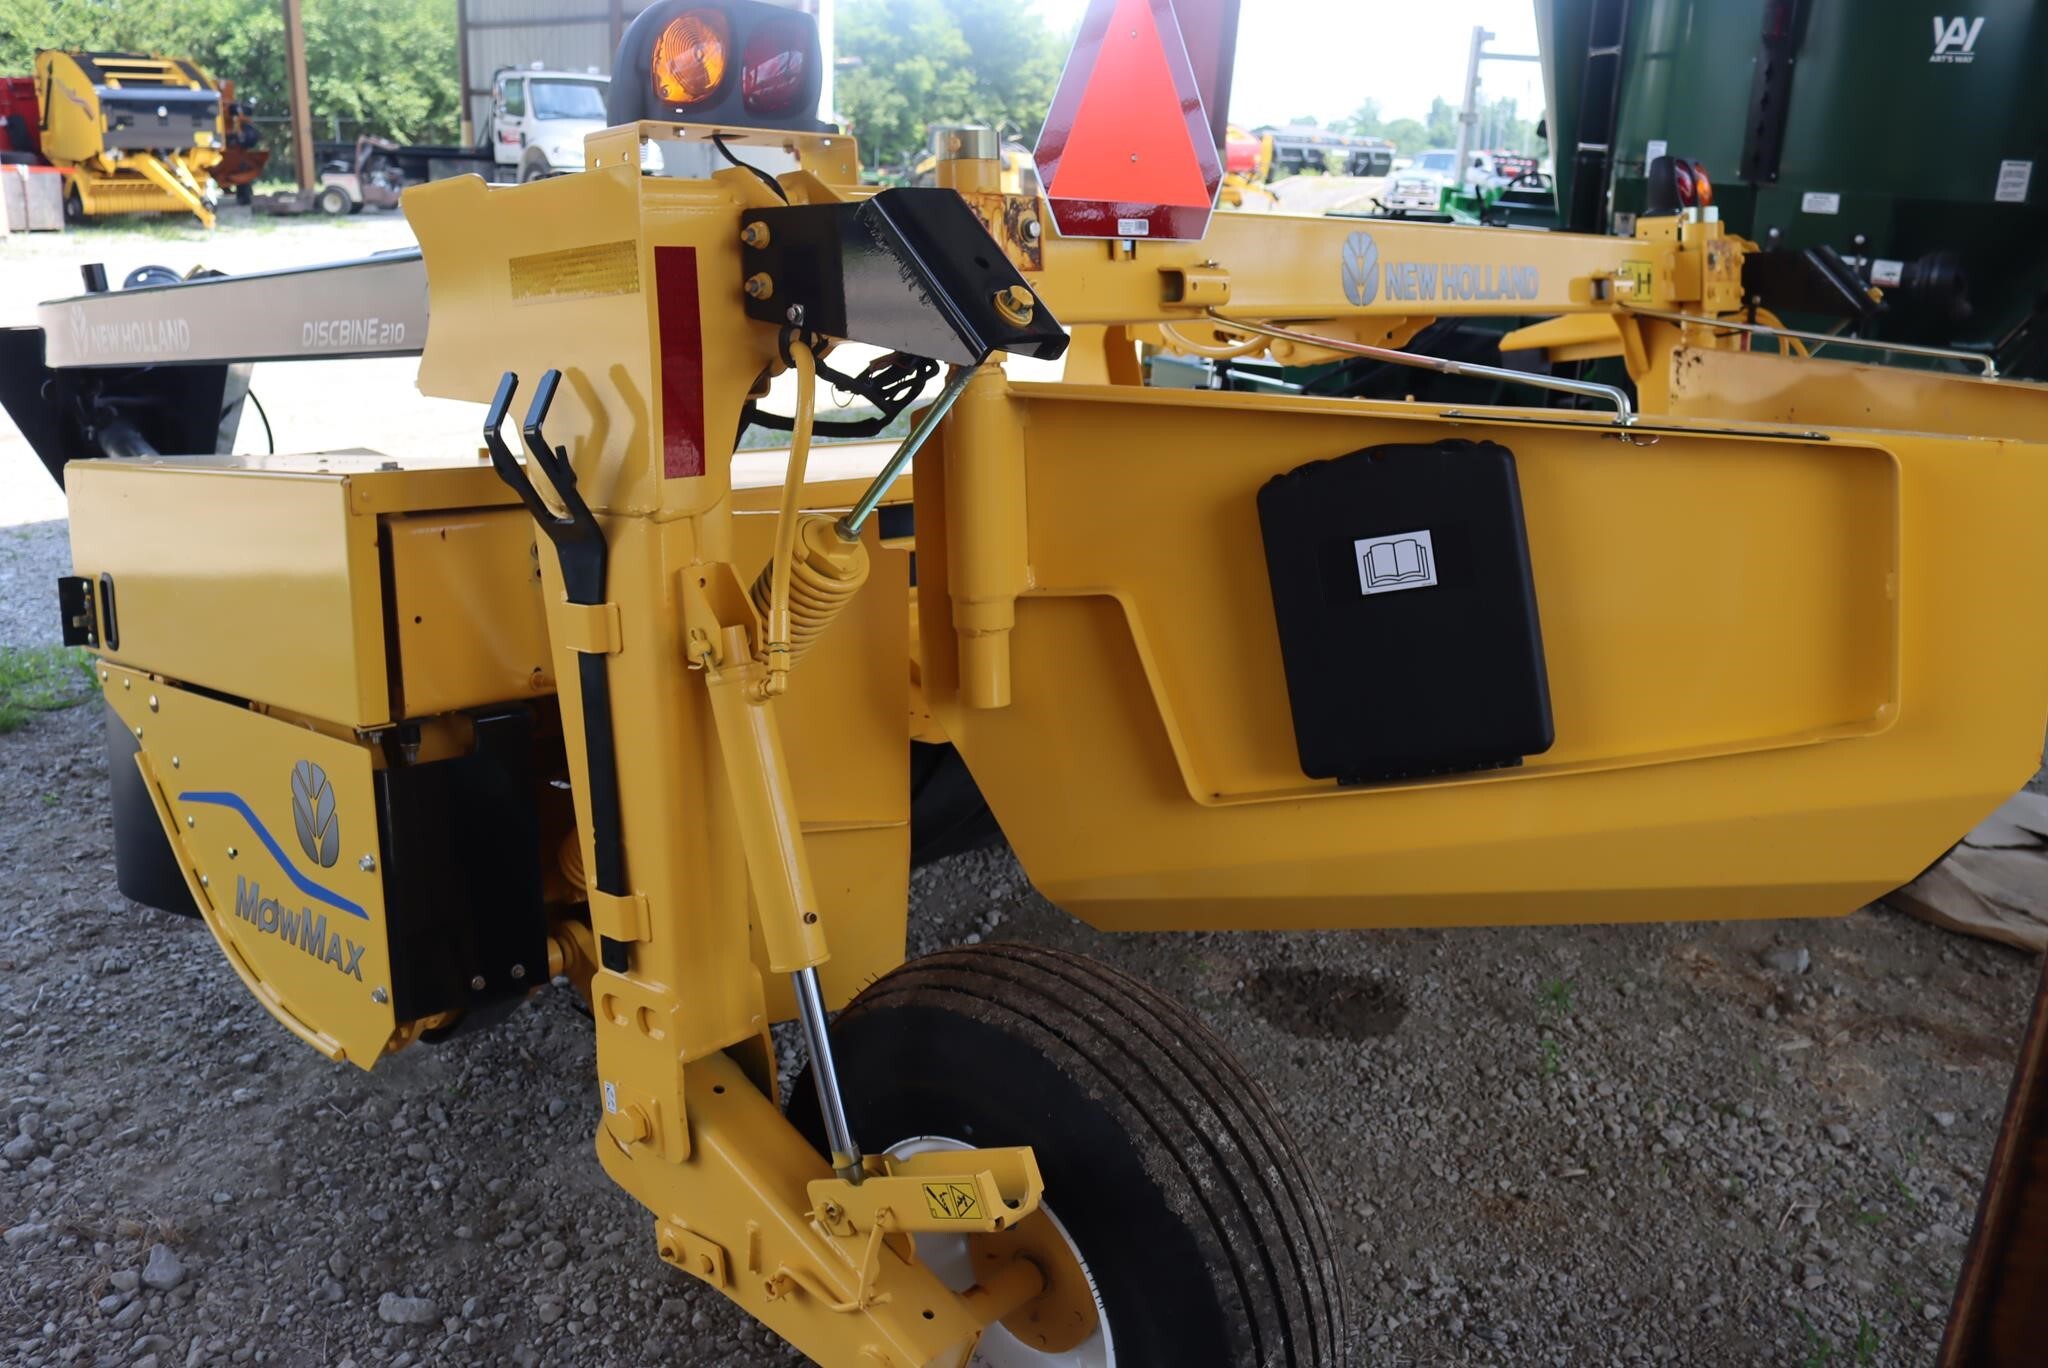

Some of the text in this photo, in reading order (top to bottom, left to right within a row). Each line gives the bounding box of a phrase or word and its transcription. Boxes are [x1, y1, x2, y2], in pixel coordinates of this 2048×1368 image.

[1384, 261, 1540, 301] NEW HOLLAND
[91, 318, 191, 354] NEW HOLLAND
[302, 317, 406, 347] DISCBINE 210
